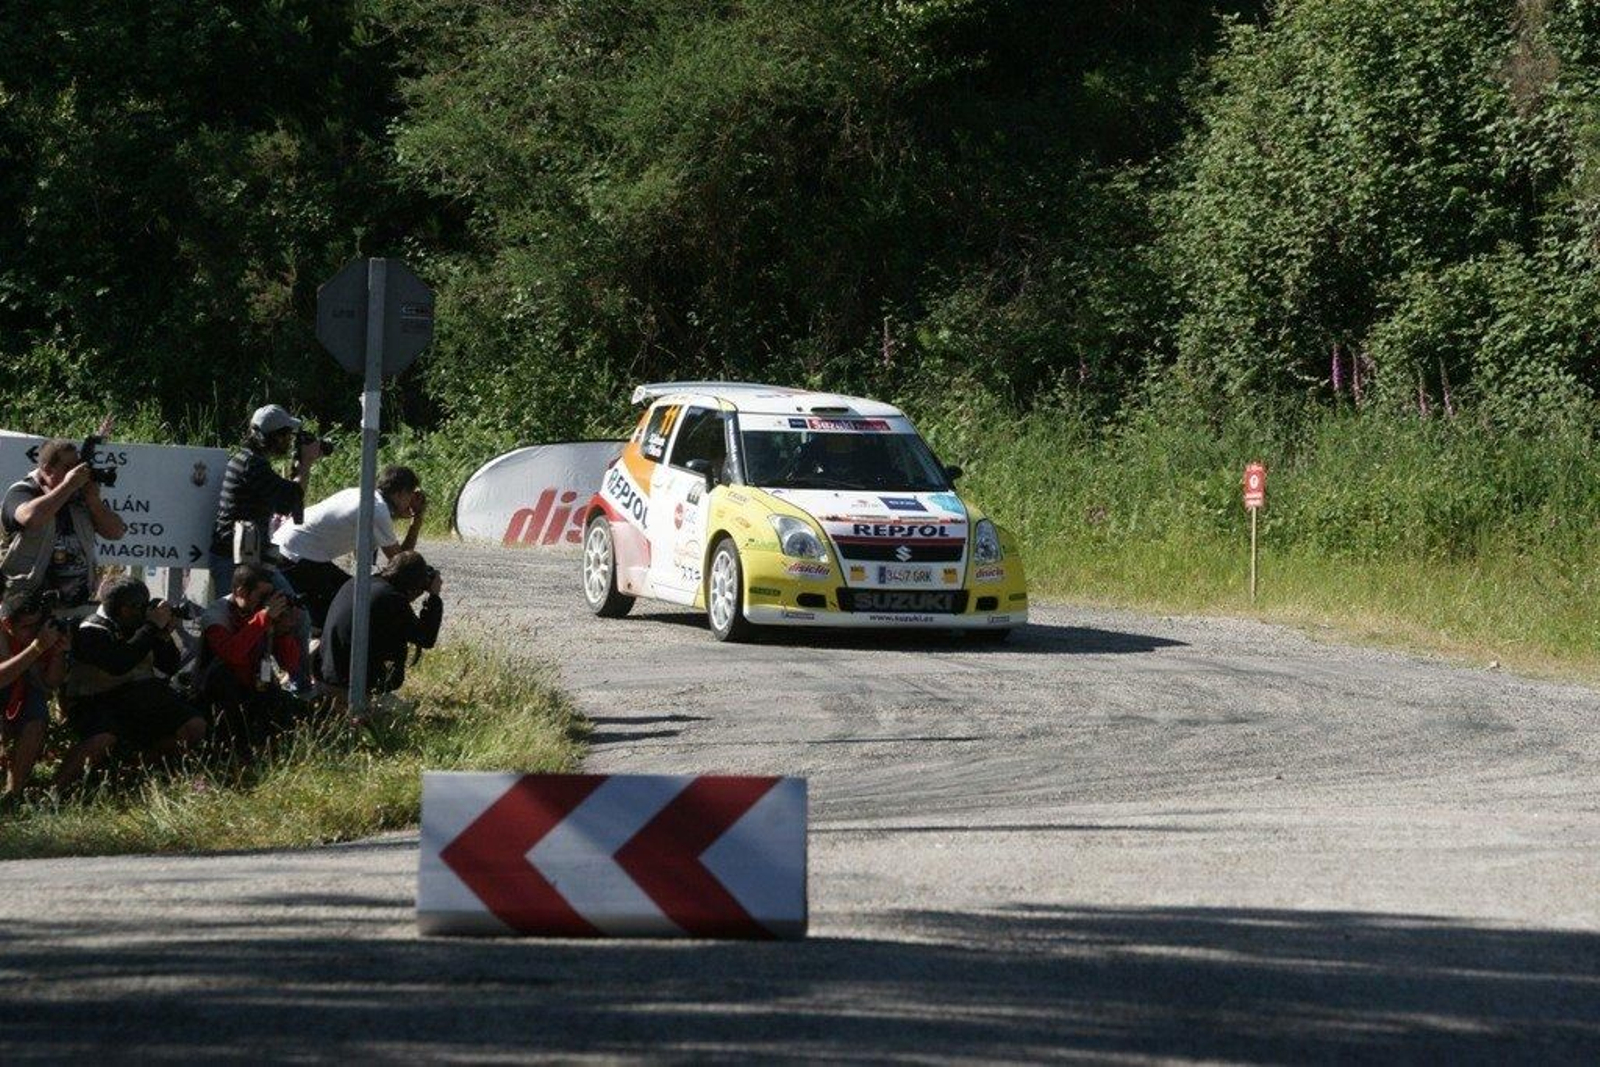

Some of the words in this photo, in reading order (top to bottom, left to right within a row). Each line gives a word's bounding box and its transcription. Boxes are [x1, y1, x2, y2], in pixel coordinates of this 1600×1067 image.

[659, 404, 681, 437] 11
[606, 467, 648, 530] REPSOL
[853, 523, 949, 538] REPSOL
[854, 591, 953, 611] SUZUKI
[869, 613, 934, 623] www.suzuki.es
